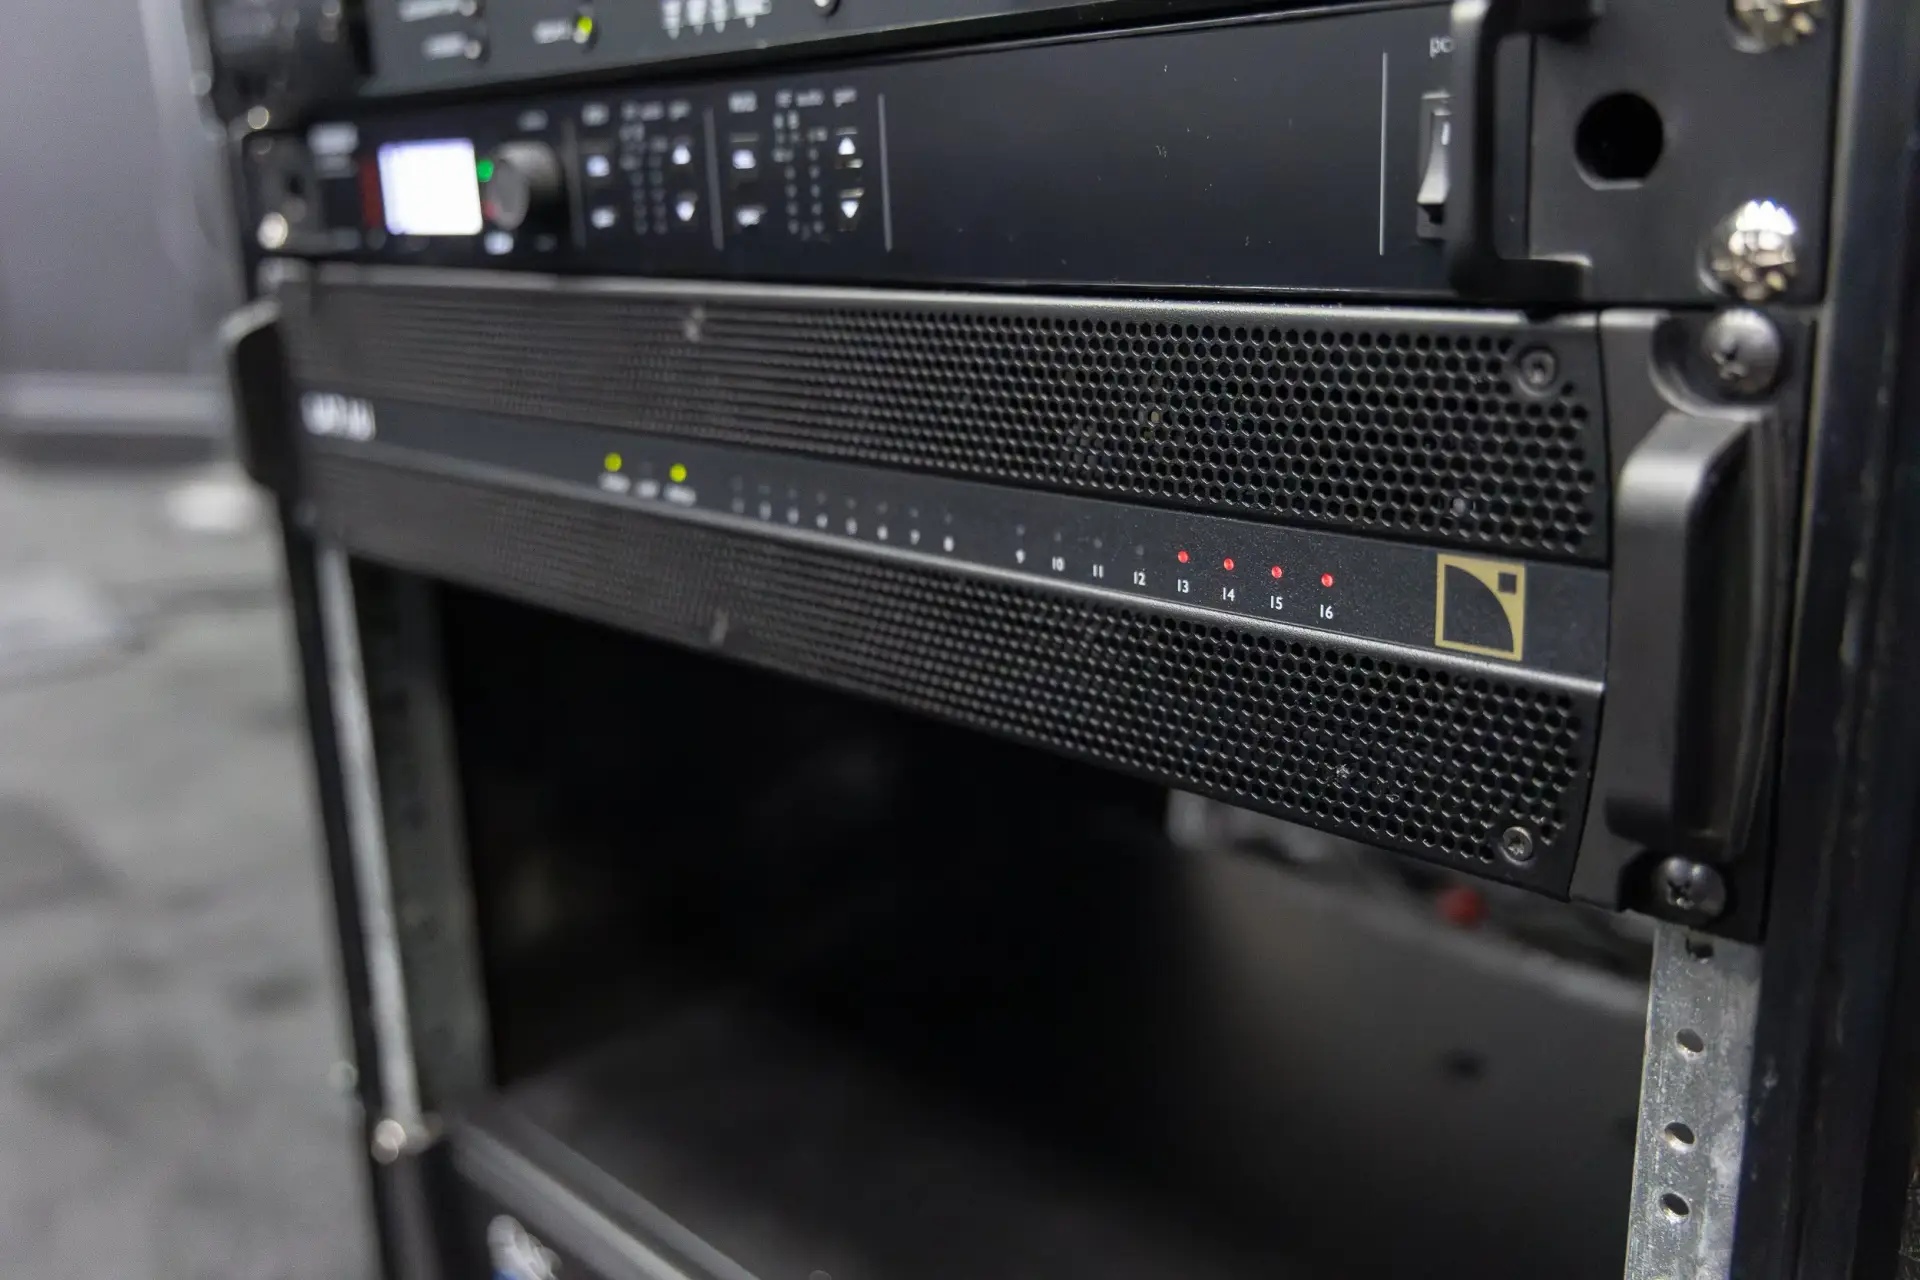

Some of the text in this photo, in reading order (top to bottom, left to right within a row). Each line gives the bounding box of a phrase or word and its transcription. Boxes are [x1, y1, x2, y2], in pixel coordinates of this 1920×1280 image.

[1051, 557, 1066, 572] 10
[1092, 564, 1105, 578] 11
[1133, 571, 1147, 586] 12
[1176, 579, 1190, 594] 13
[1222, 587, 1236, 602] 14
[1269, 595, 1283, 611] 15
[1319, 604, 1334, 620] 16
